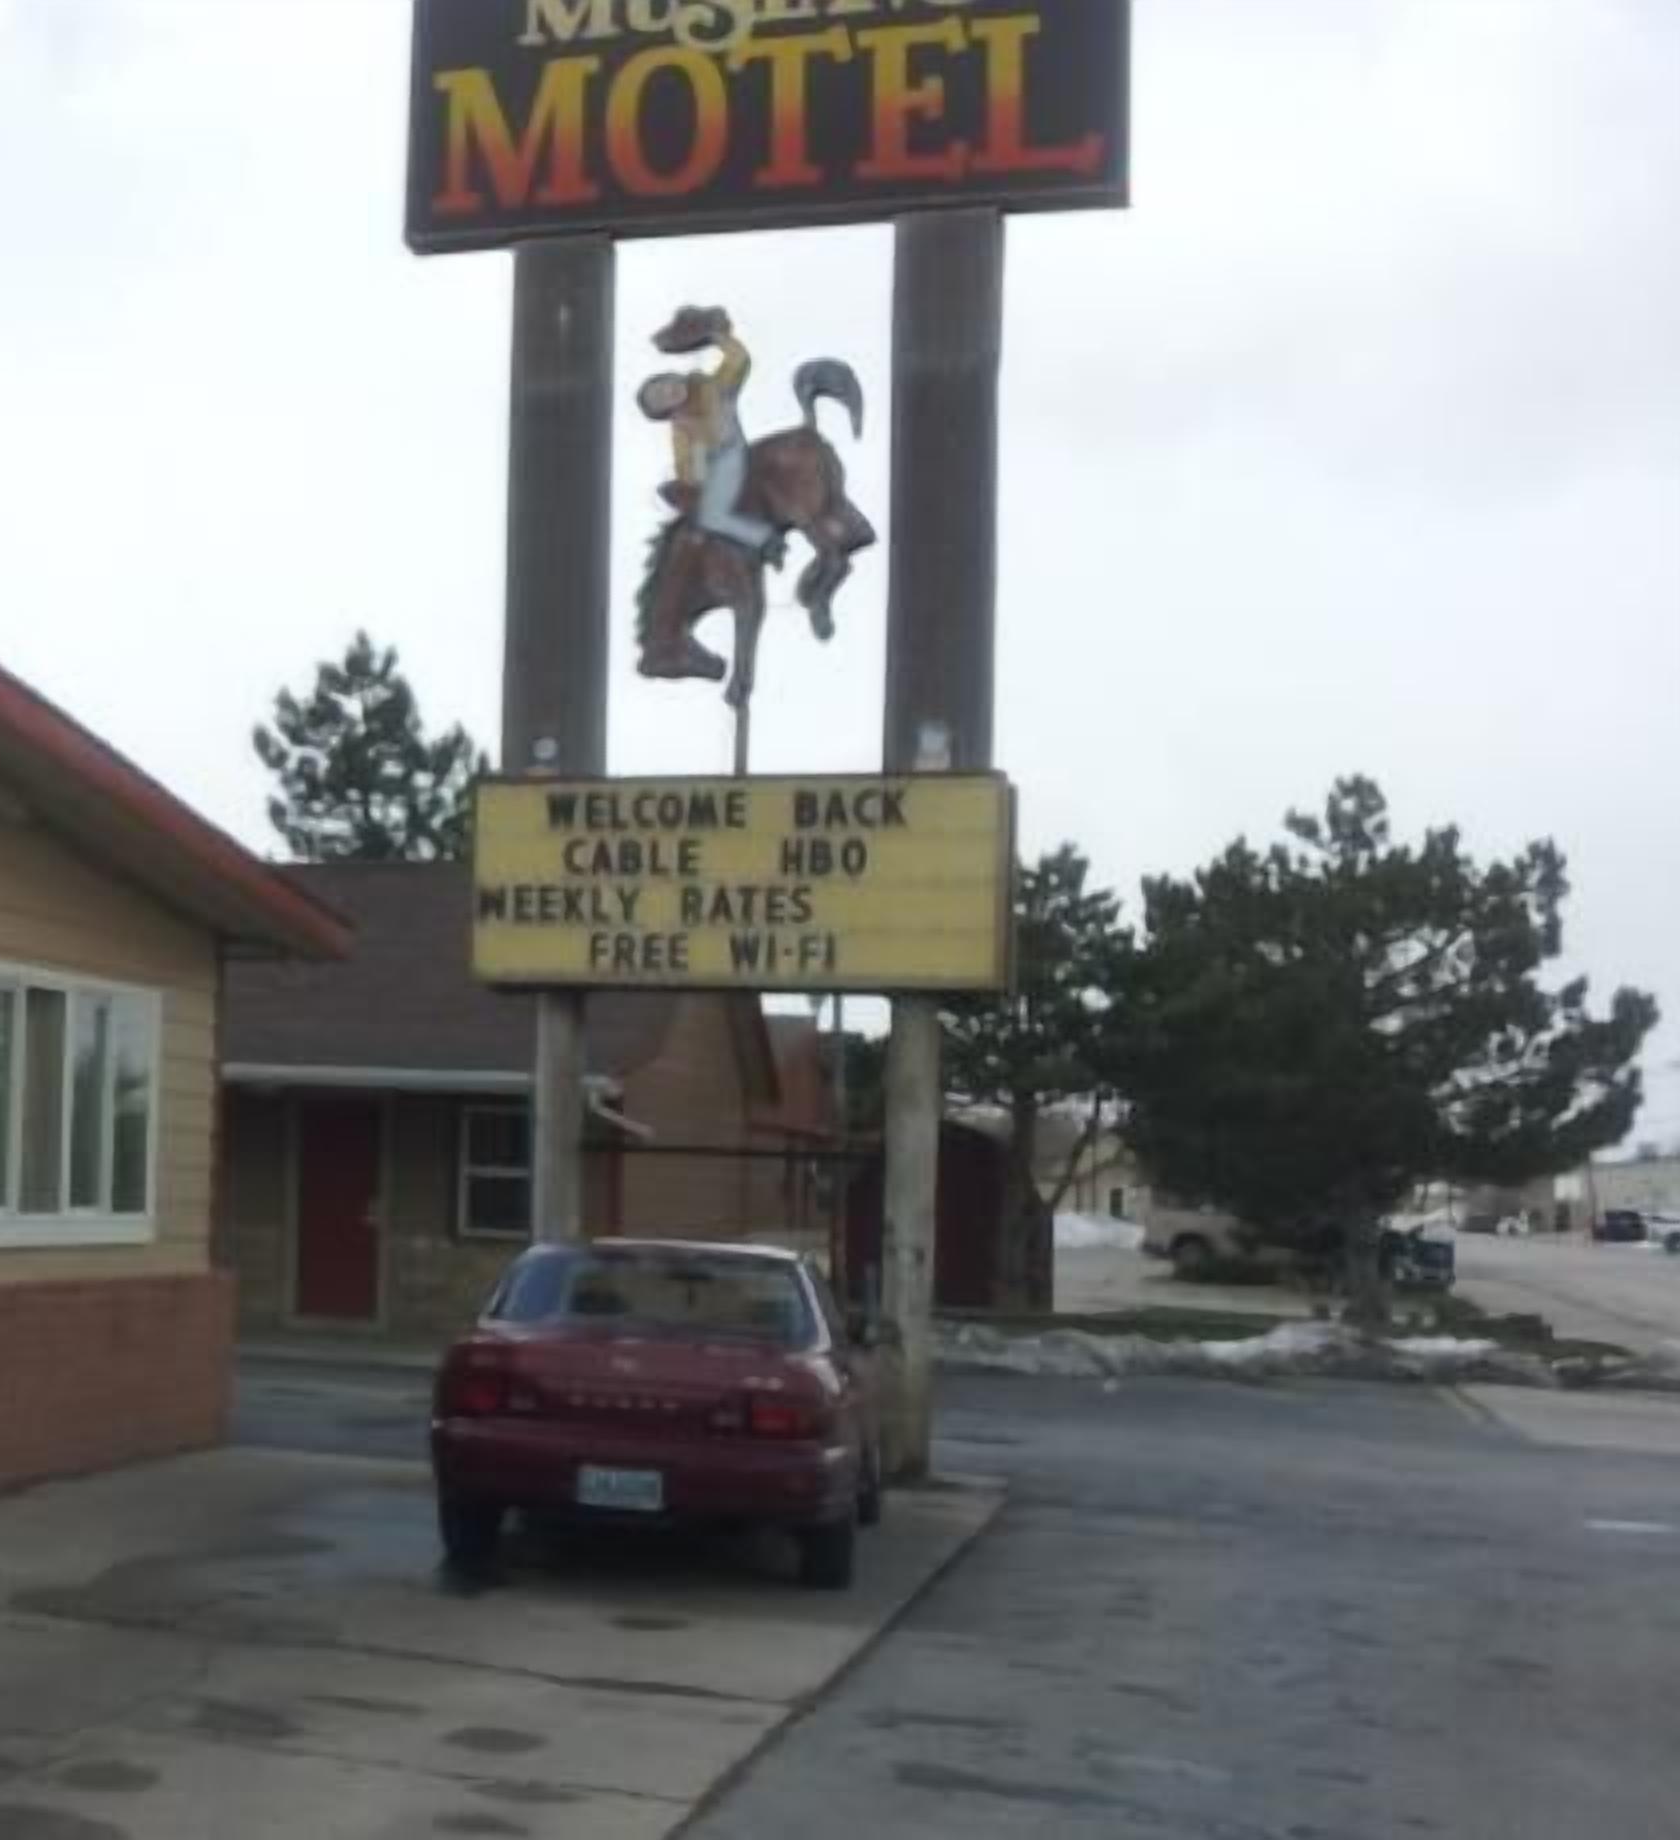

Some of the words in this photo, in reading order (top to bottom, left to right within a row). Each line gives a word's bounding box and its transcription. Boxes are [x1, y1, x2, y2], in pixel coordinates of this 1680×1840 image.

[431, 14, 1106, 214] MOTEL
[546, 790, 748, 831] WELCOME
[793, 788, 909, 830] BACK
[561, 839, 702, 877] CABLE
[780, 837, 868, 877] HBO
[478, 884, 641, 925] WEEKLY
[679, 884, 813, 925] RATES
[589, 931, 689, 971] FREE
[729, 932, 837, 971] WI-FI
